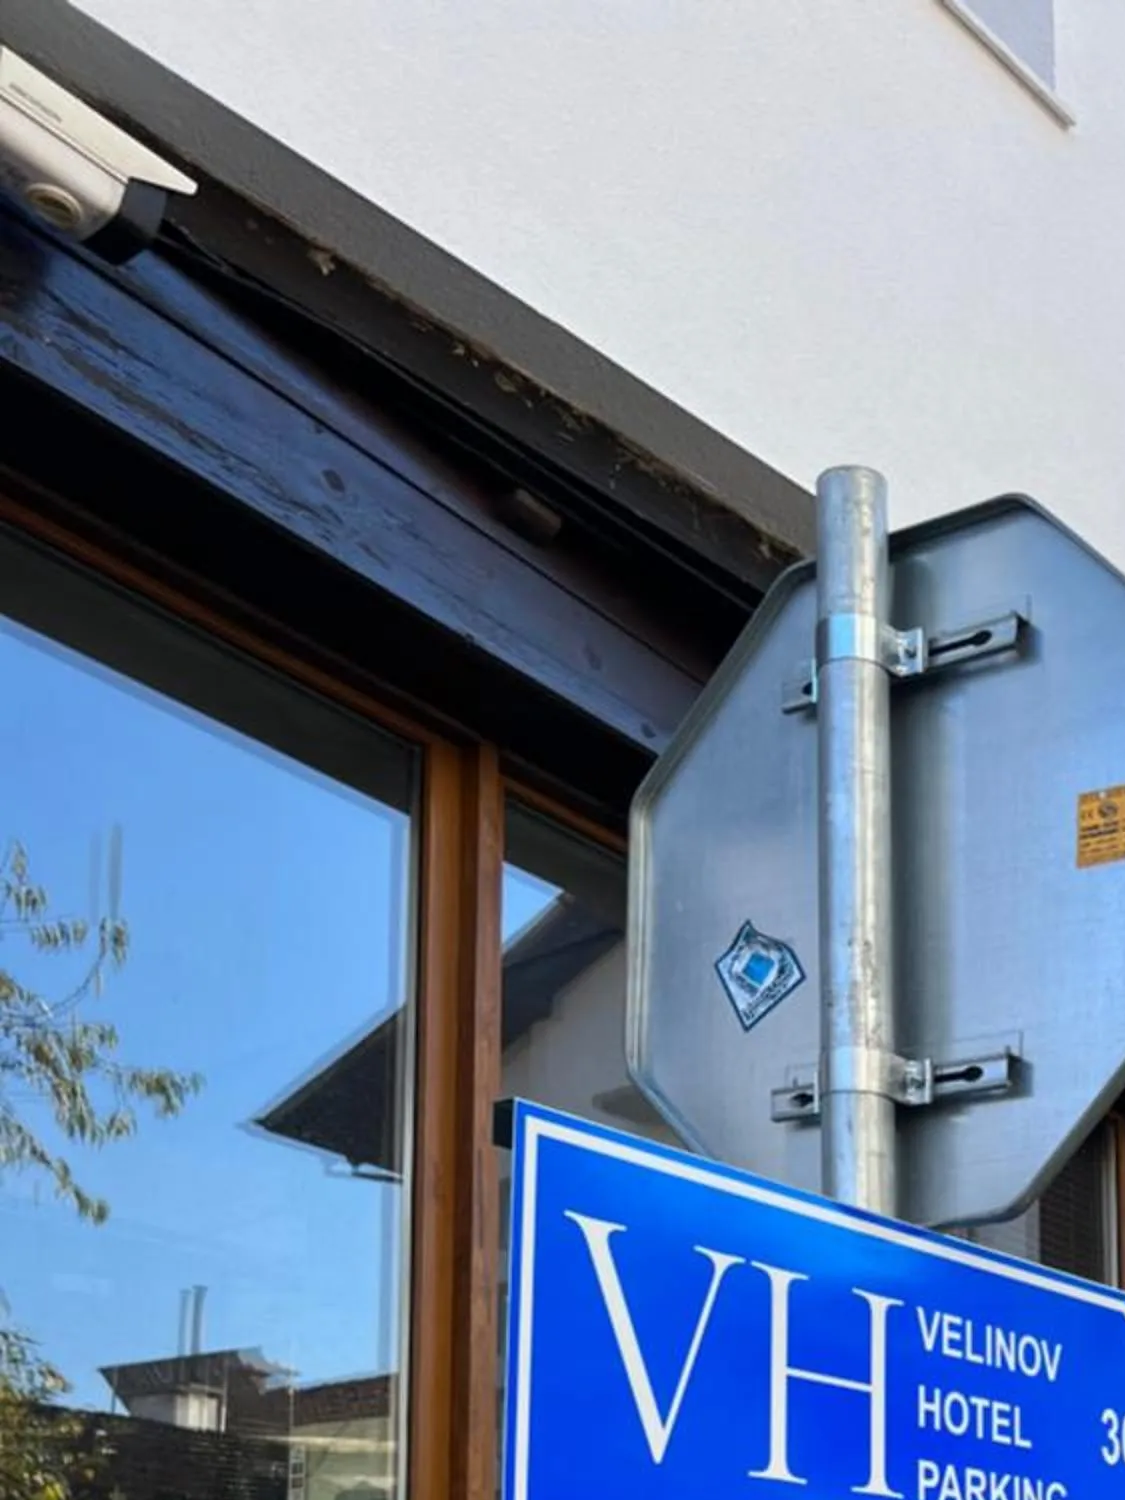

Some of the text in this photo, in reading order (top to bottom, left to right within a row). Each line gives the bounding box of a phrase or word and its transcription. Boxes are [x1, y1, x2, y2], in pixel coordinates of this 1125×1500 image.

[564, 1210, 904, 1500] VH
[916, 1306, 1062, 1382] VELINOV
[917, 1384, 1033, 1449] HOTEL
